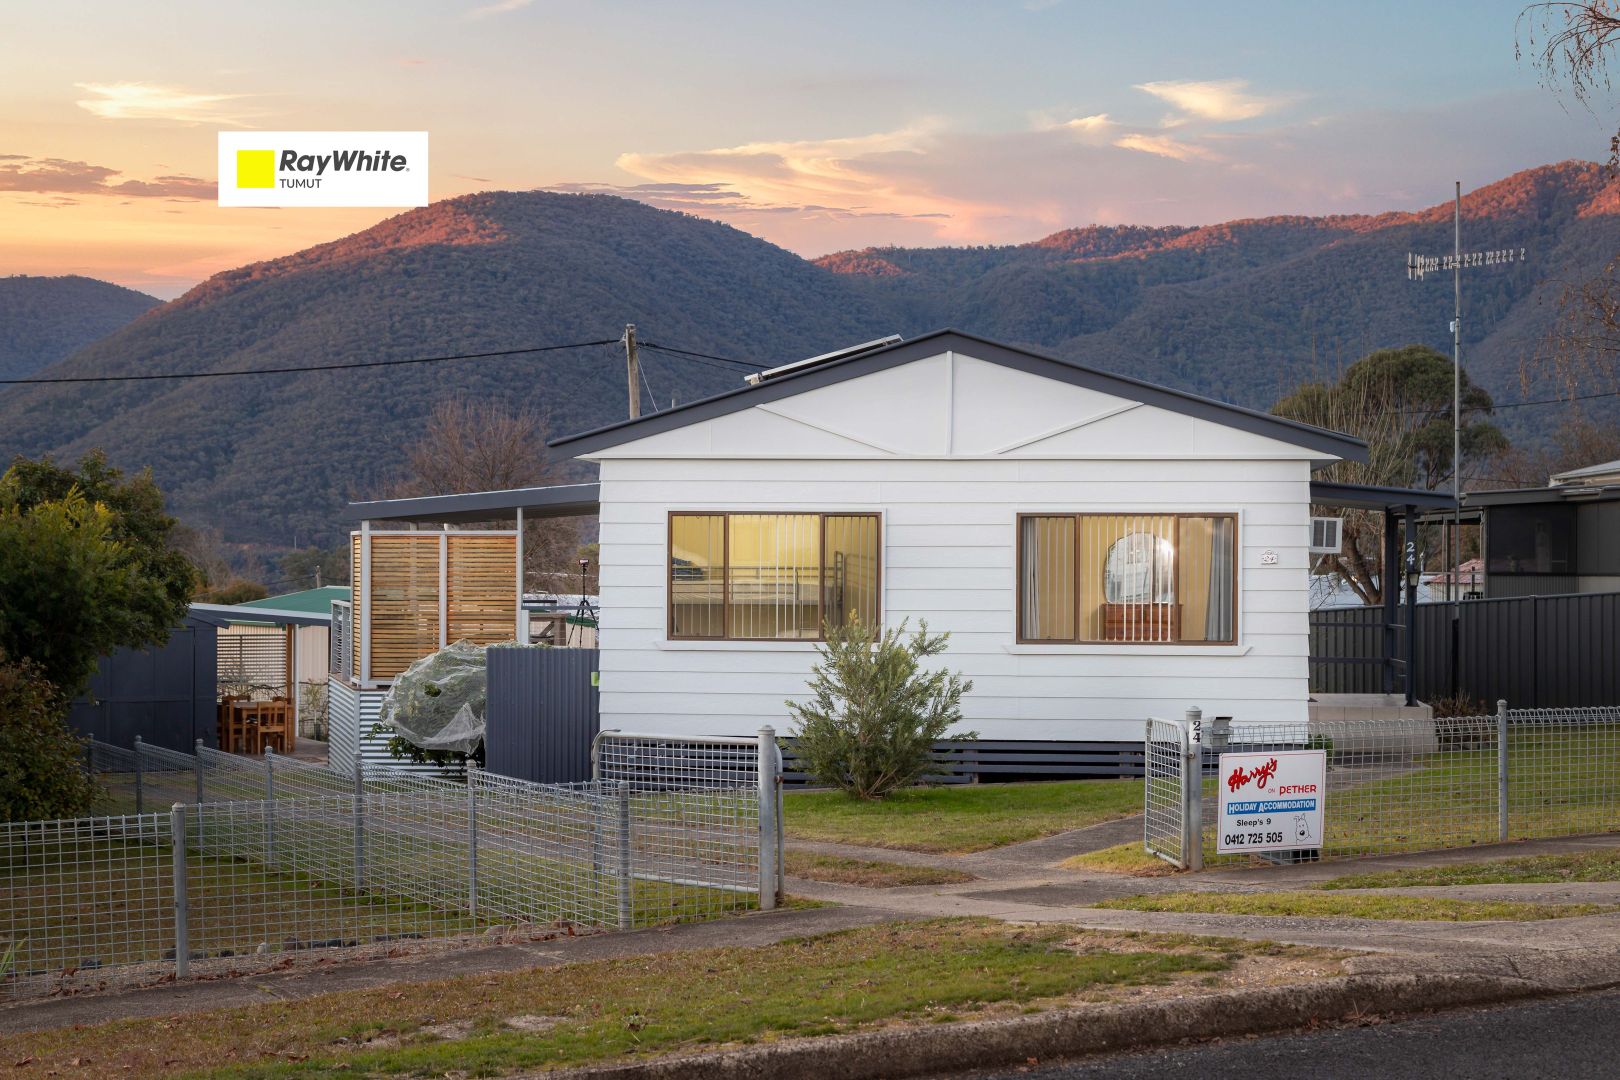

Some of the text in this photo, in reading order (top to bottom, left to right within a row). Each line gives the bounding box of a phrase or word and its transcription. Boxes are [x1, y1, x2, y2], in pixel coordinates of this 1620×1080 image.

[1406, 541, 1416, 565] 24
[1192, 720, 1201, 743] 24
[1227, 757, 1278, 793] Harry's
[1279, 784, 1317, 796] PETHER
[1228, 799, 1315, 814] HOLIDAY ACCOMMODATION
[1236, 817, 1272, 828] Sleep's 9
[1224, 831, 1283, 846] 0412 725 505
